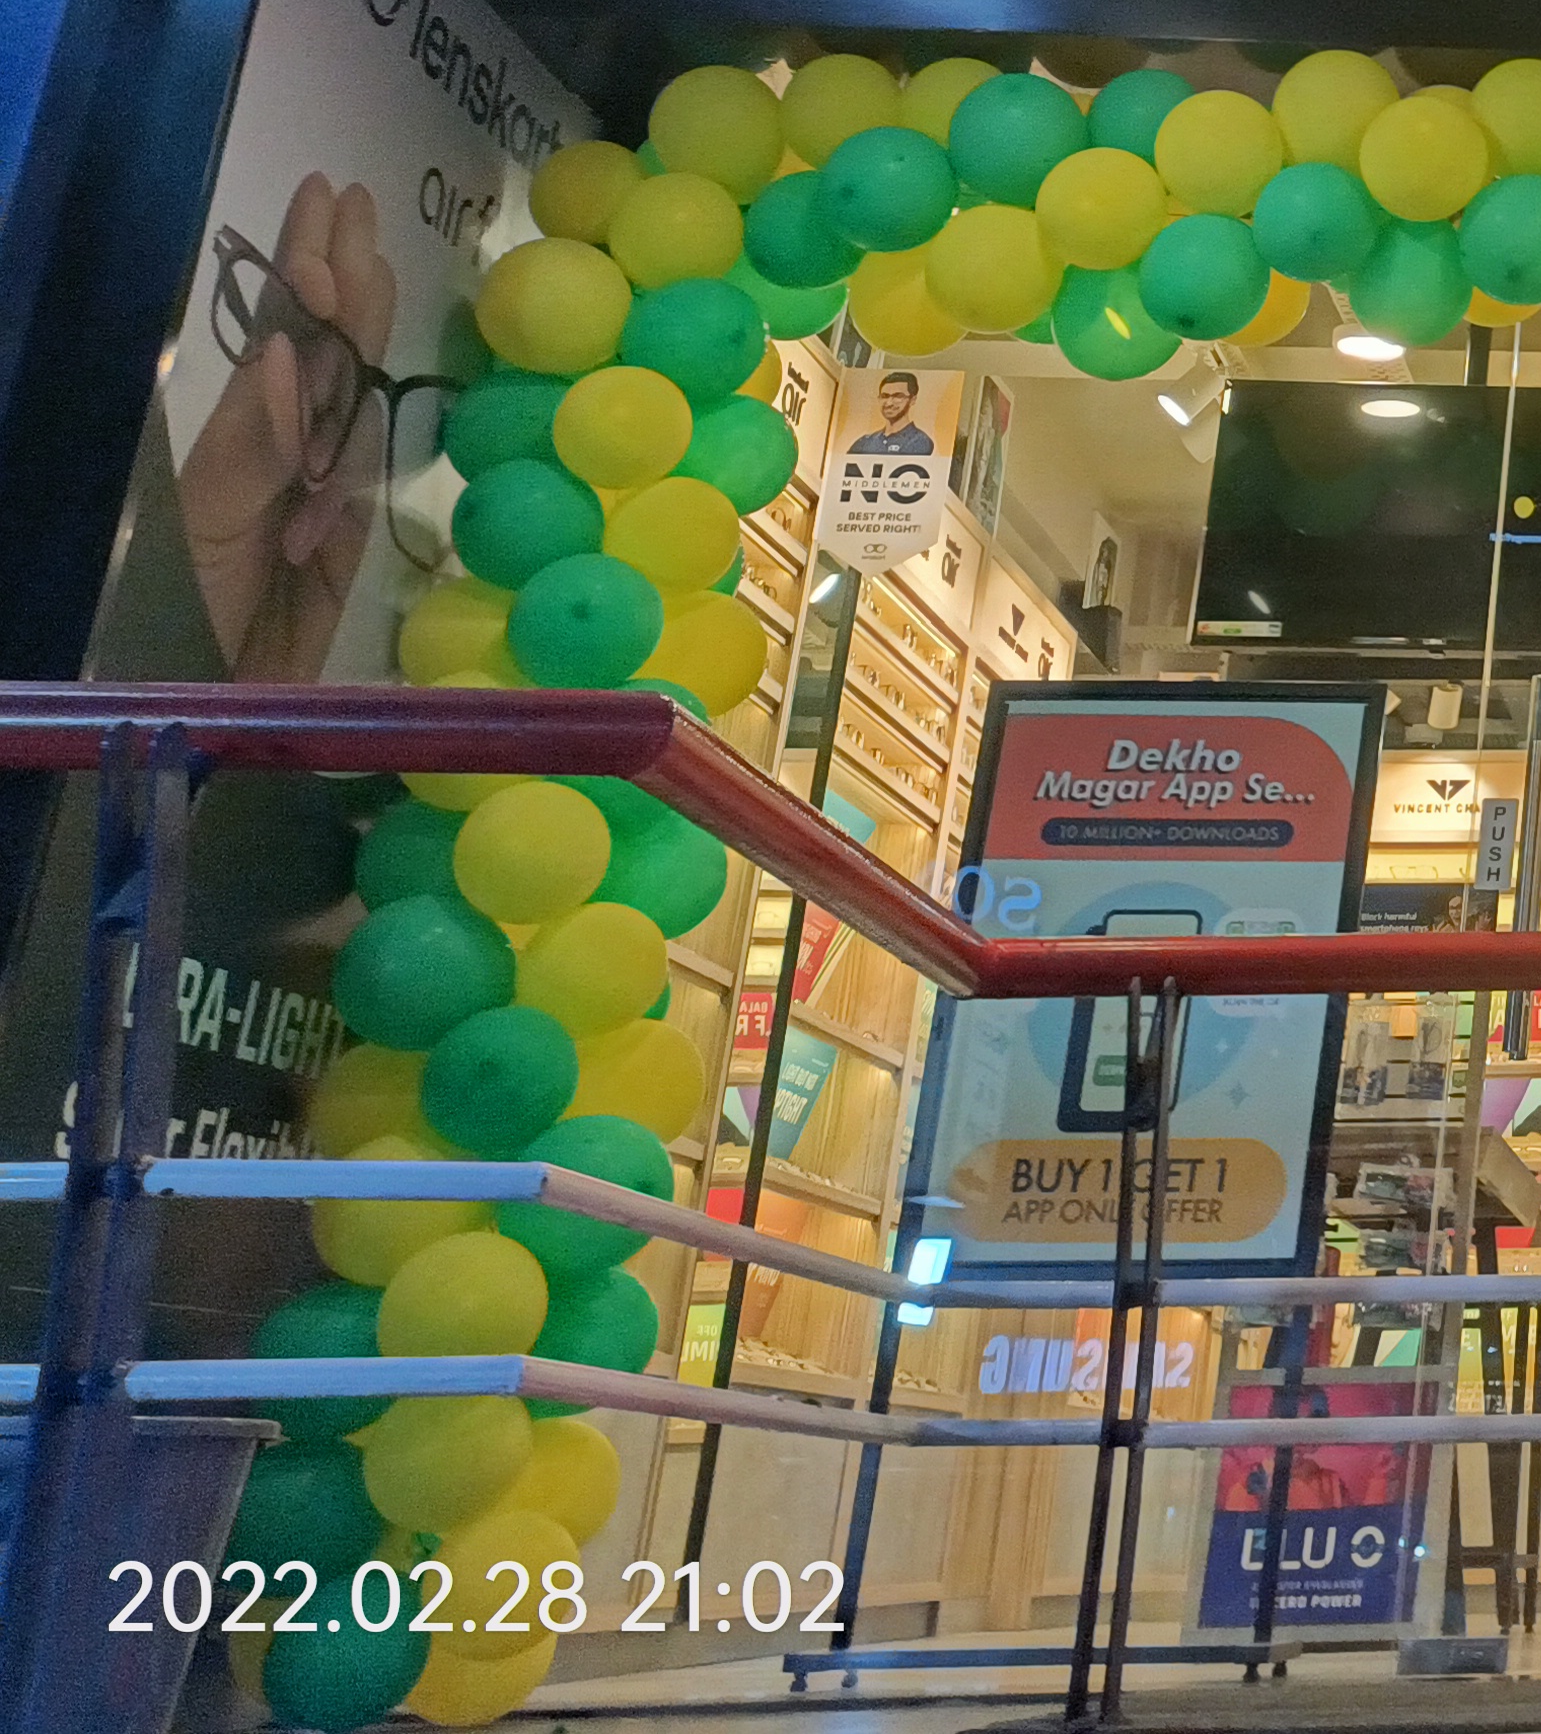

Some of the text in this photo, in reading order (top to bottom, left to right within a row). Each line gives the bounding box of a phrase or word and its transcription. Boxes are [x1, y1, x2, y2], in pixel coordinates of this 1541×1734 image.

[839, 462, 931, 505] NO
[841, 479, 931, 489] MIDDLEMEN
[836, 523, 881, 533] SERVED
[848, 512, 912, 522] BEST PRICE
[1106, 738, 1242, 774] Dekho
[1034, 770, 1316, 809] Magar App Se...
[1393, 802, 1481, 814] VINCENT CHA
[1166, 825, 1281, 842] DOWNLOADS
[1486, 806, 1508, 882] PUSH
[121, 942, 345, 1078] LRA-LIGH
[1011, 1158, 1229, 1194] BUY 1 GET 1
[1002, 1199, 1055, 1225] APP
[1058, 1199, 1132, 1225] ONL
[1309, 1593, 1363, 1609] POWER
